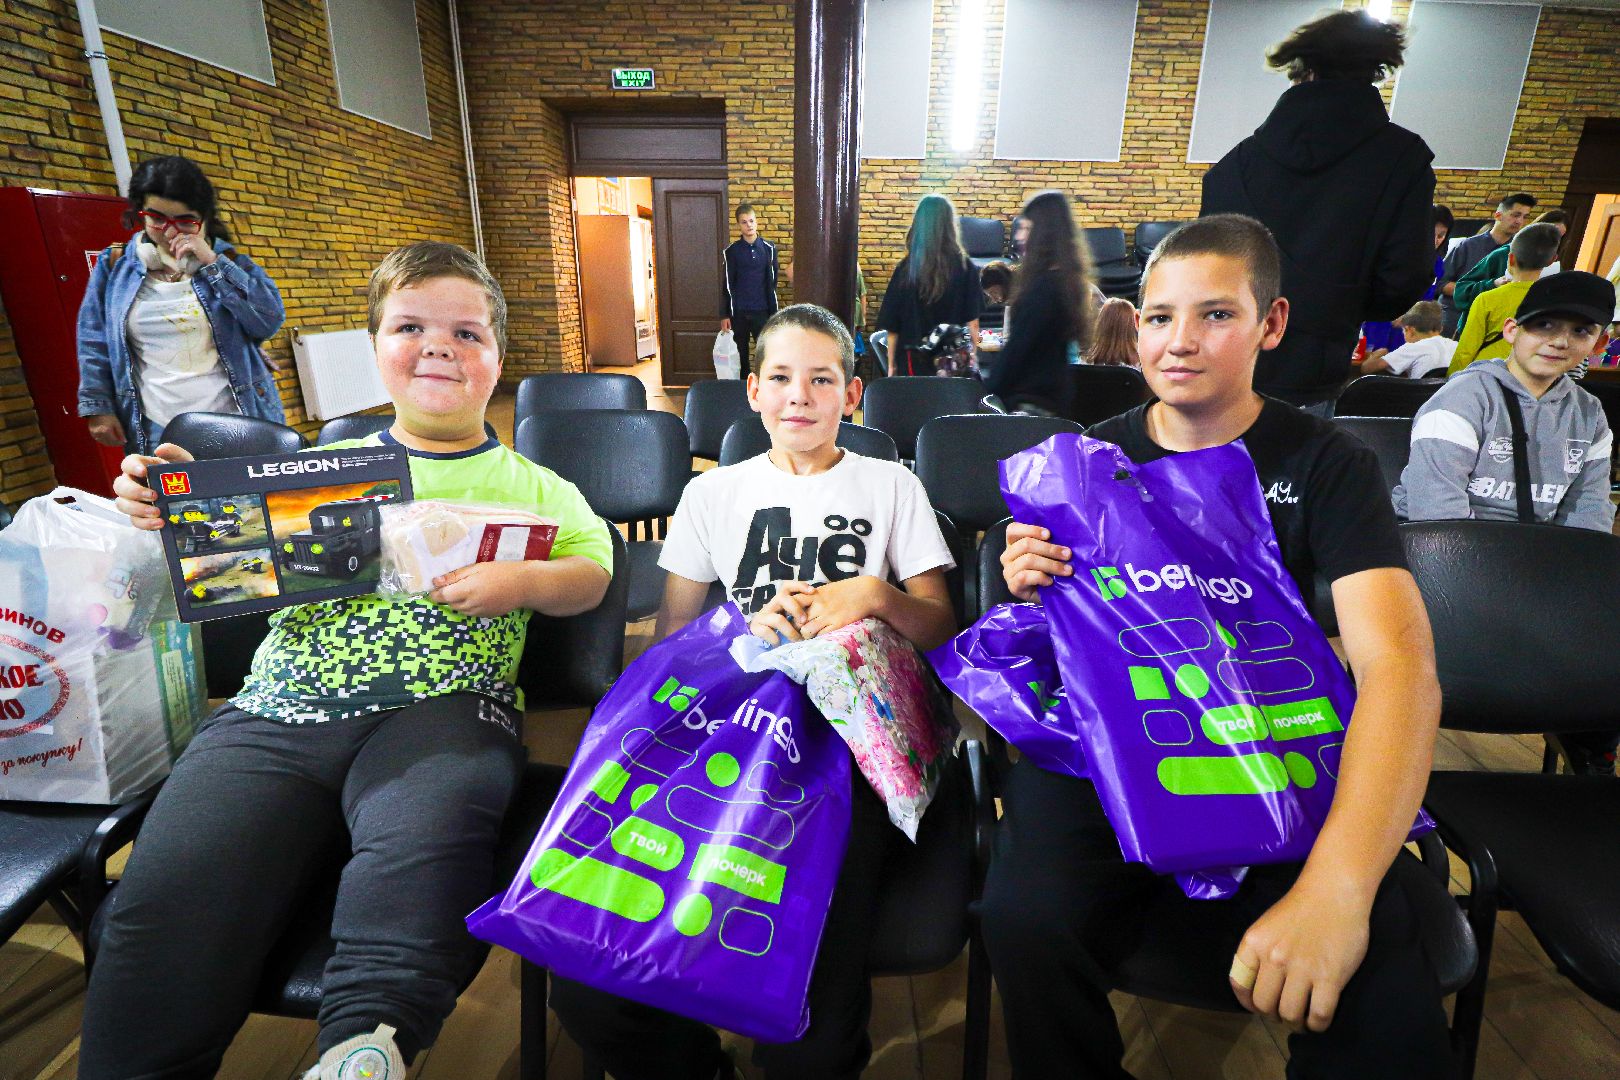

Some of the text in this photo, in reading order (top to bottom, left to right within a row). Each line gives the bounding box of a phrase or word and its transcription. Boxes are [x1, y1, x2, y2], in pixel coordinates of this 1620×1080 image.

[615, 69, 651, 81] ВЫХОД
[621, 79, 646, 87] EXIT
[246, 457, 340, 479] LEGION
[0, 607, 66, 644] ИНОВ
[1273, 711, 1326, 730] почерк
[17, 737, 83, 768] покупку!
[629, 831, 668, 857] твой
